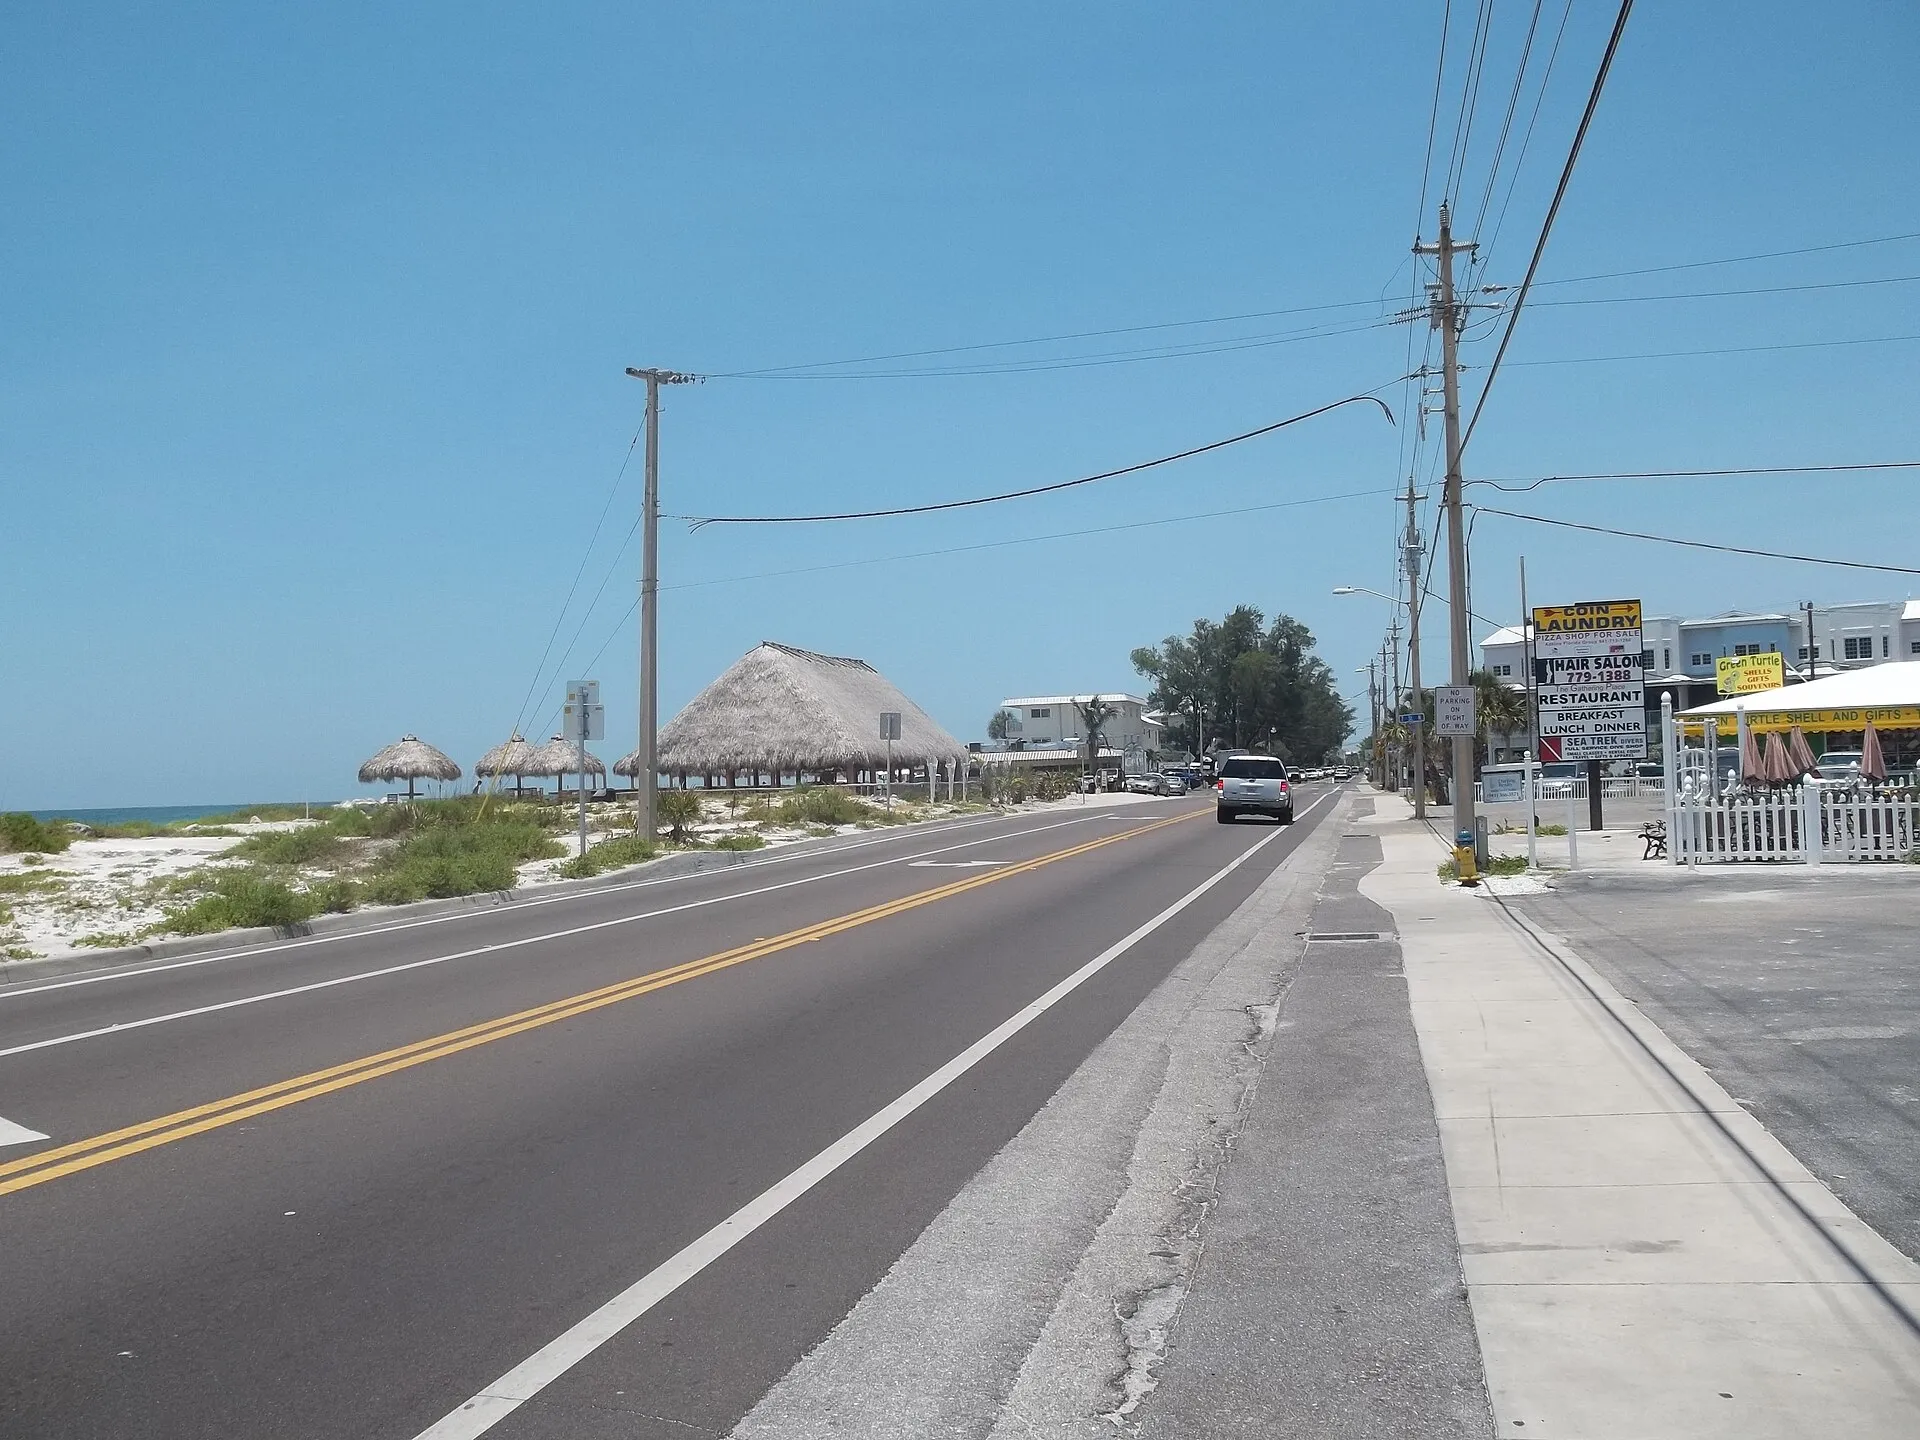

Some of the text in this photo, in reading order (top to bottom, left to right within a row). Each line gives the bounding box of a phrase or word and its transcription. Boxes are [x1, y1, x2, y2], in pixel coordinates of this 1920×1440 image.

[1563, 605, 1610, 617] COIN
[1536, 615, 1639, 632] LAUNDRY
[1536, 630, 1640, 642] PIZZA SHOP FOR SALE
[1555, 656, 1642, 671] HAIR SALON
[1749, 655, 1780, 668] Turtle
[1567, 670, 1631, 683] 779-1388
[1743, 667, 1772, 676] SHELLS
[1746, 674, 1770, 683] GIFTS
[1570, 684, 1604, 693] Gathering
[1605, 683, 1626, 691] Place
[1736, 682, 1782, 692] SOUVENIRS
[1439, 697, 1471, 705] PARKING
[1539, 691, 1642, 705] RESTAURANT
[1445, 714, 1465, 722] RIGHT
[1557, 710, 1625, 722] BREAKFAST
[1688, 716, 1728, 727] GREN
[1786, 711, 1825, 724] SHELL
[1832, 711, 1859, 721] AND
[1865, 709, 1902, 721] GIFTS
[1544, 722, 1641, 735] LUNCH DINNER
[1566, 737, 1587, 747] SEA
[1590, 736, 1618, 745] TREK
